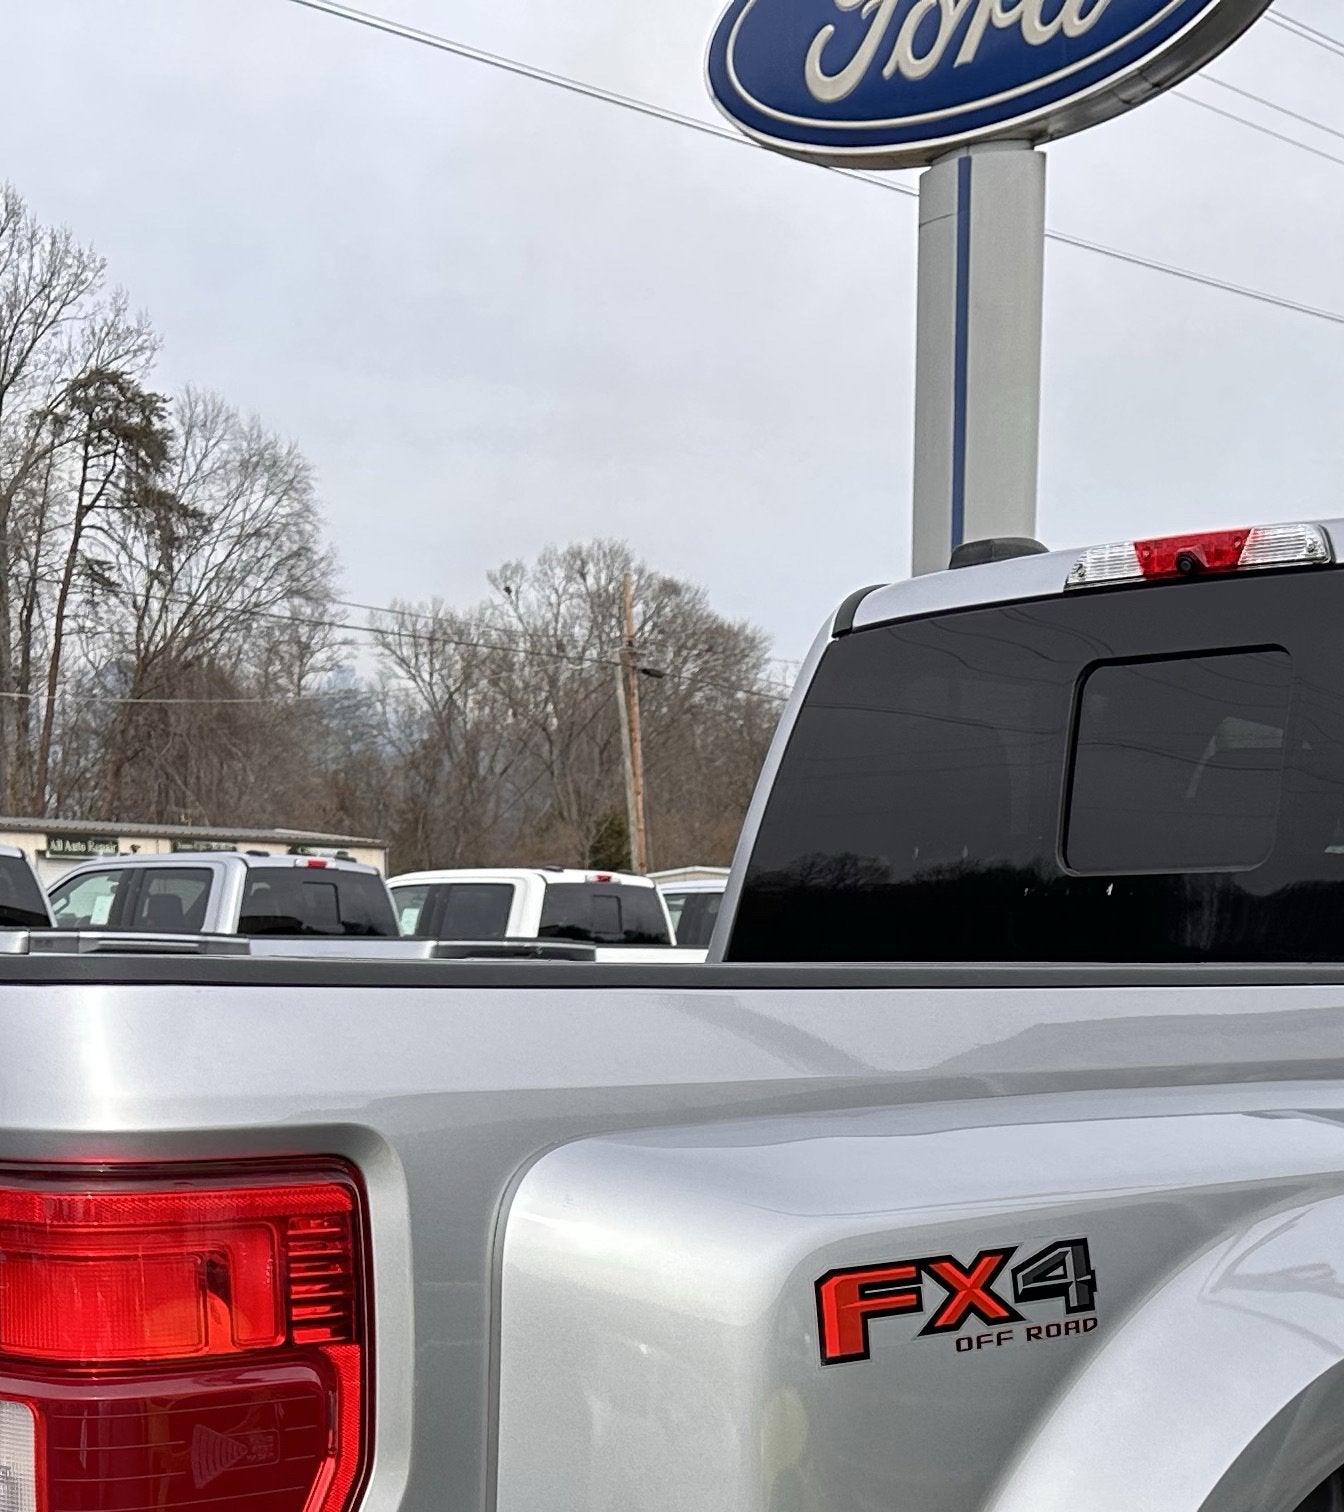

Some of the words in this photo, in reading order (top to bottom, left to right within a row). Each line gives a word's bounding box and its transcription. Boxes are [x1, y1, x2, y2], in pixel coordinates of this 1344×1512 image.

[64, 840, 86, 852] Auto
[814, 1237, 1098, 1367] FX4
[955, 1329, 1014, 1353] OFF
[1026, 1316, 1098, 1342] ROAD
